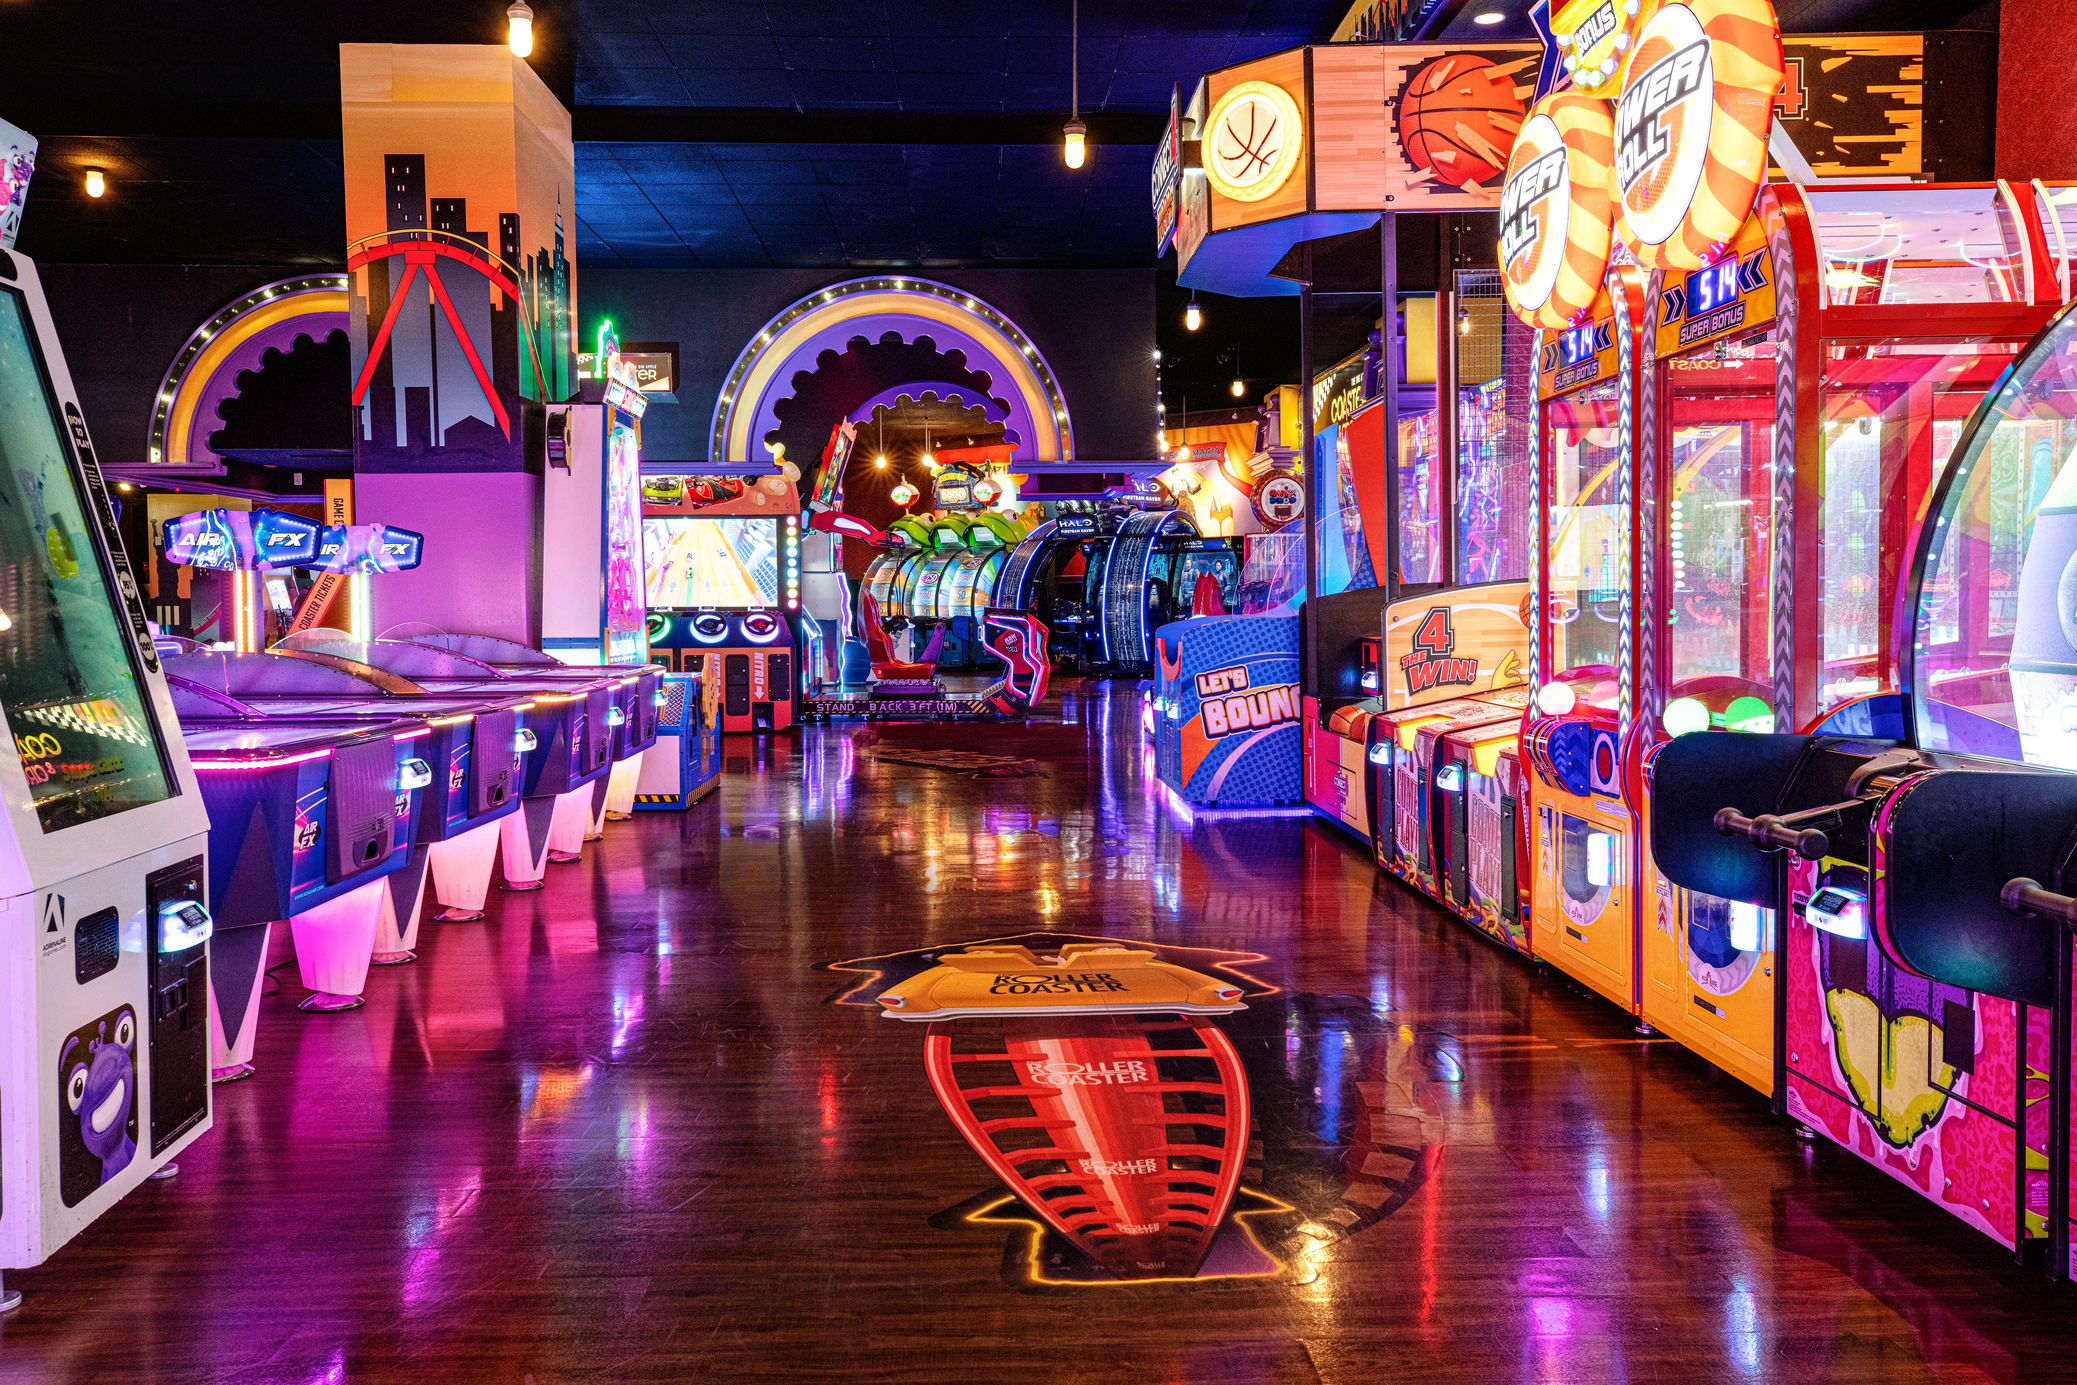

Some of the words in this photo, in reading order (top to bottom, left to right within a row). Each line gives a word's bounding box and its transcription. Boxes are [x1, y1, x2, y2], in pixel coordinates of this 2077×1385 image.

[1574, 1, 1617, 57] BONUS
[1615, 43, 1706, 148] OWER
[1773, 60, 1806, 117] 4
[1500, 150, 1565, 234] OWER
[1680, 321, 1709, 343] SUPER
[1711, 304, 1744, 331] BONUS
[1555, 368, 1575, 390] SUPER
[1576, 360, 1598, 379] BONUS
[1192, 446, 1221, 460] MAGIC
[333, 498, 344, 518] GAME
[1059, 519, 1093, 528] HALO
[178, 532, 221, 547] AIR
[266, 532, 308, 548] FX
[320, 543, 341, 555] IR
[377, 543, 412, 555] FX
[299, 600, 321, 631] COASTER
[315, 574, 336, 603] TICKETS
[957, 590, 966, 600] 50
[1416, 609, 1452, 654] 4
[1402, 650, 1427, 669] THE
[753, 652, 764, 685] NITRO
[1408, 659, 1477, 692] WIN!
[1198, 667, 1248, 695] LET'S
[816, 703, 855, 712] STAND
[869, 703, 902, 711] BACK
[936, 702, 957, 712] (1M)
[302, 820, 319, 836] AIR
[299, 833, 317, 851] FX
[43, 937, 67, 951] ADRENALINE
[993, 973, 1120, 985] ROLLER
[989, 982, 1131, 995] COASTER
[1027, 1061, 1147, 1075] ROLLER
[1031, 1071, 1149, 1086] COASTER
[1079, 1158, 1157, 1168] ROLLER
[1083, 1166, 1158, 1176] COASTER
[1115, 1222, 1160, 1230] ROLLER
